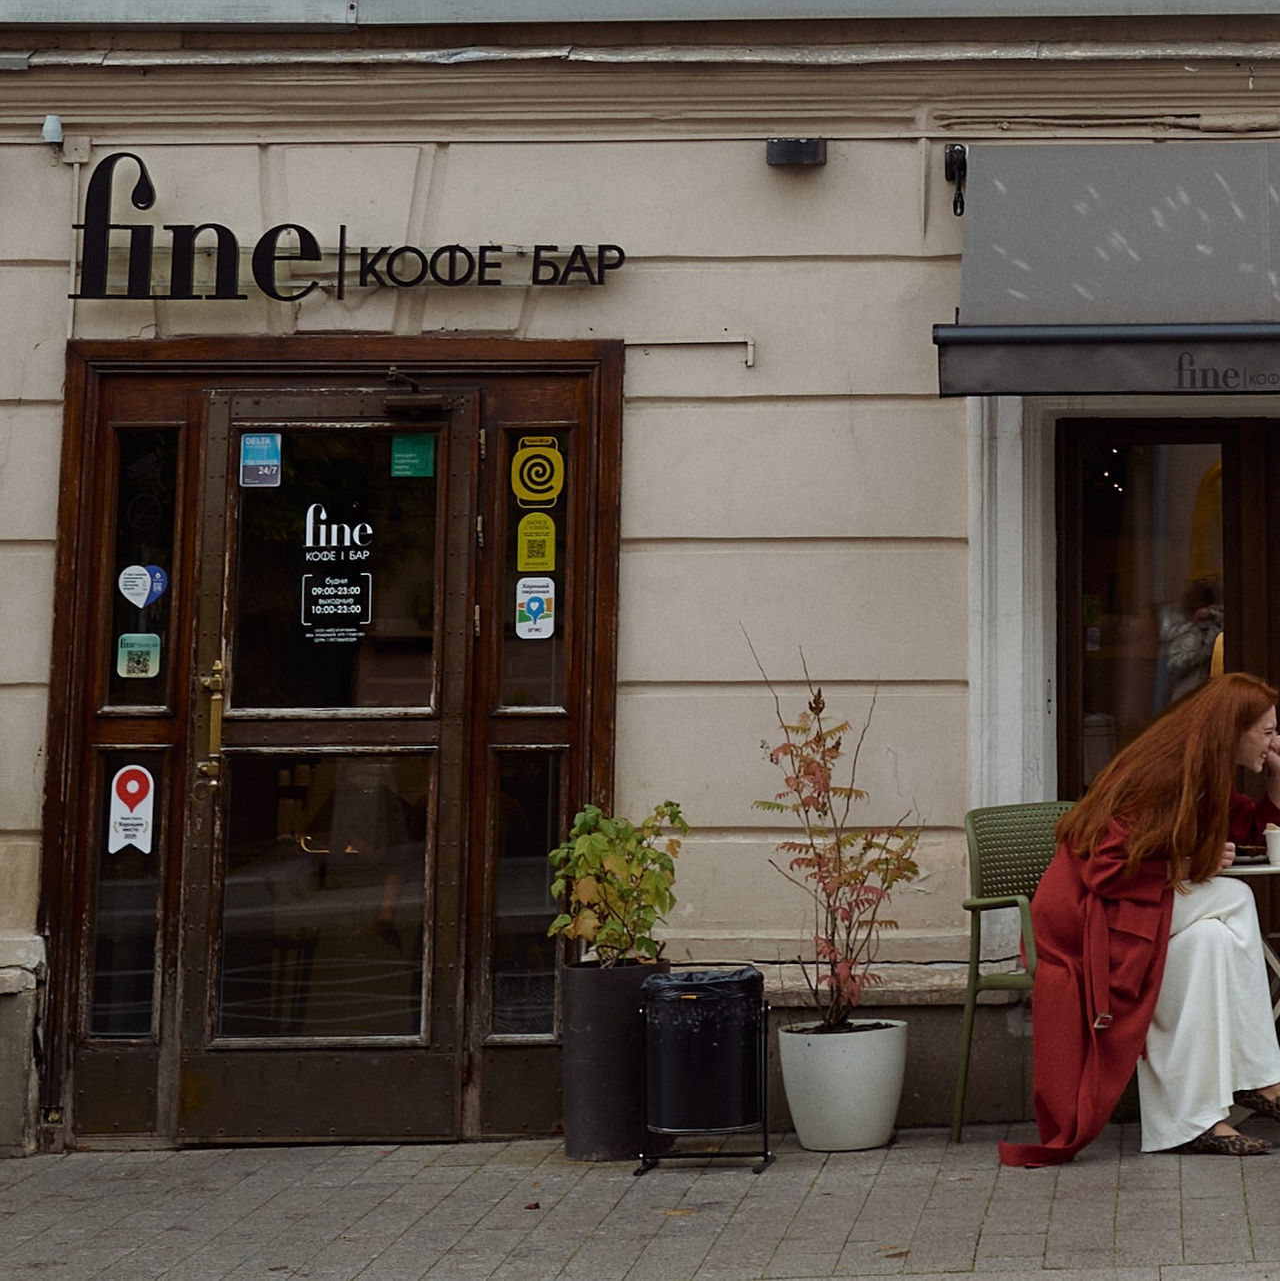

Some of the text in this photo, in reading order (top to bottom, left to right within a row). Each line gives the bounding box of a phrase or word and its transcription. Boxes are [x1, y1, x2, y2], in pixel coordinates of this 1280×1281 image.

[68, 152, 626, 302] fine КОФЕ БАР
[1174, 351, 1240, 389] fine
[245, 437, 271, 445] DELTA
[258, 466, 278, 475] 24/7
[302, 503, 373, 547] fine
[305, 550, 370, 561] КОФЕ БАР
[311, 587, 361, 596] 09:00-23:00
[311, 605, 362, 614] 10:00-23:00
